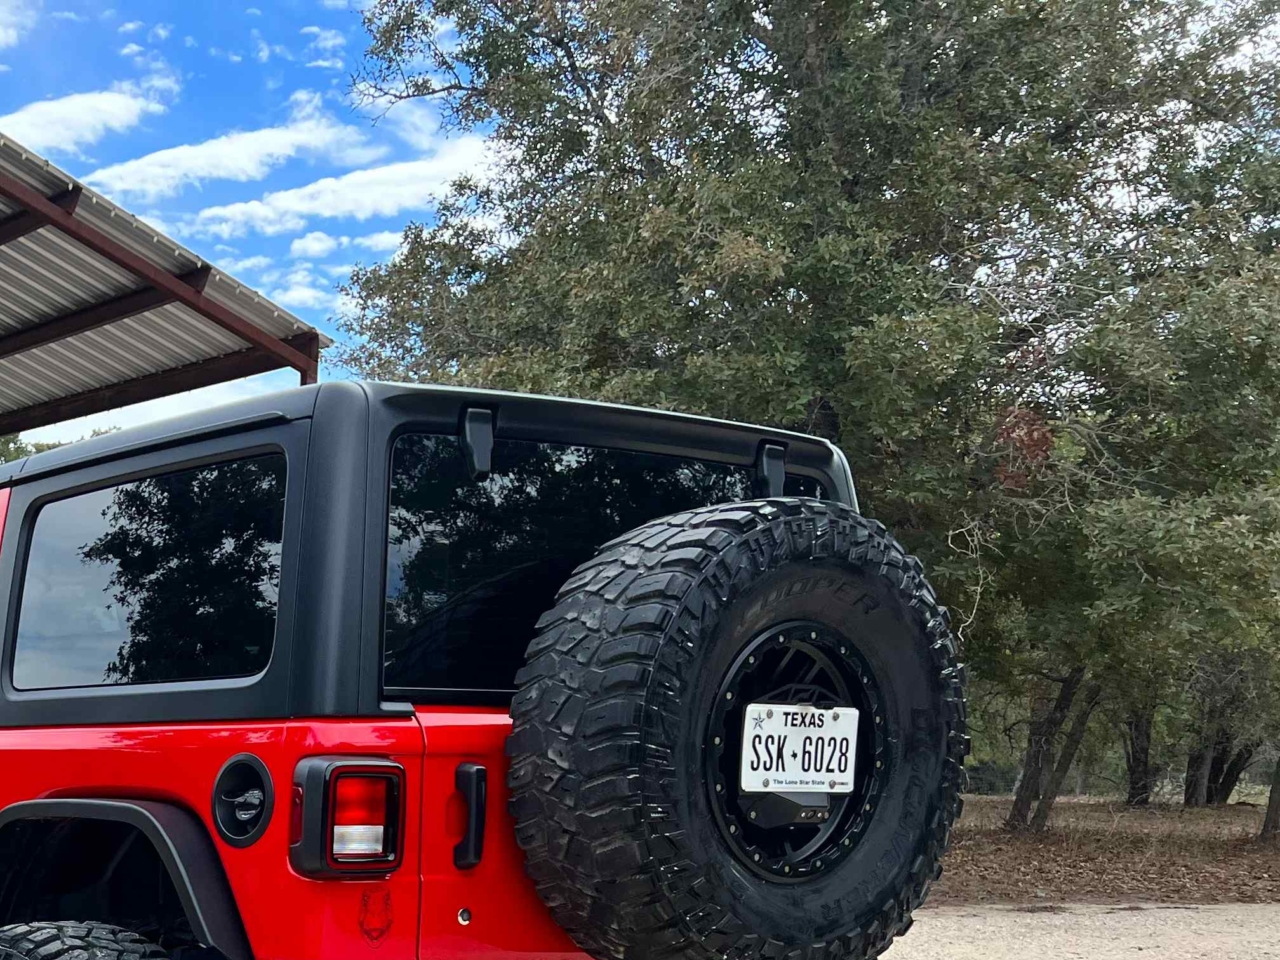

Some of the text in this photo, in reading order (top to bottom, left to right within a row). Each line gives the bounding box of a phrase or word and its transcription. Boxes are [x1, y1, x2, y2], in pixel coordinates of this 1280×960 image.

[783, 712, 825, 728] TEXAS
[751, 734, 849, 773] SSK 6028
